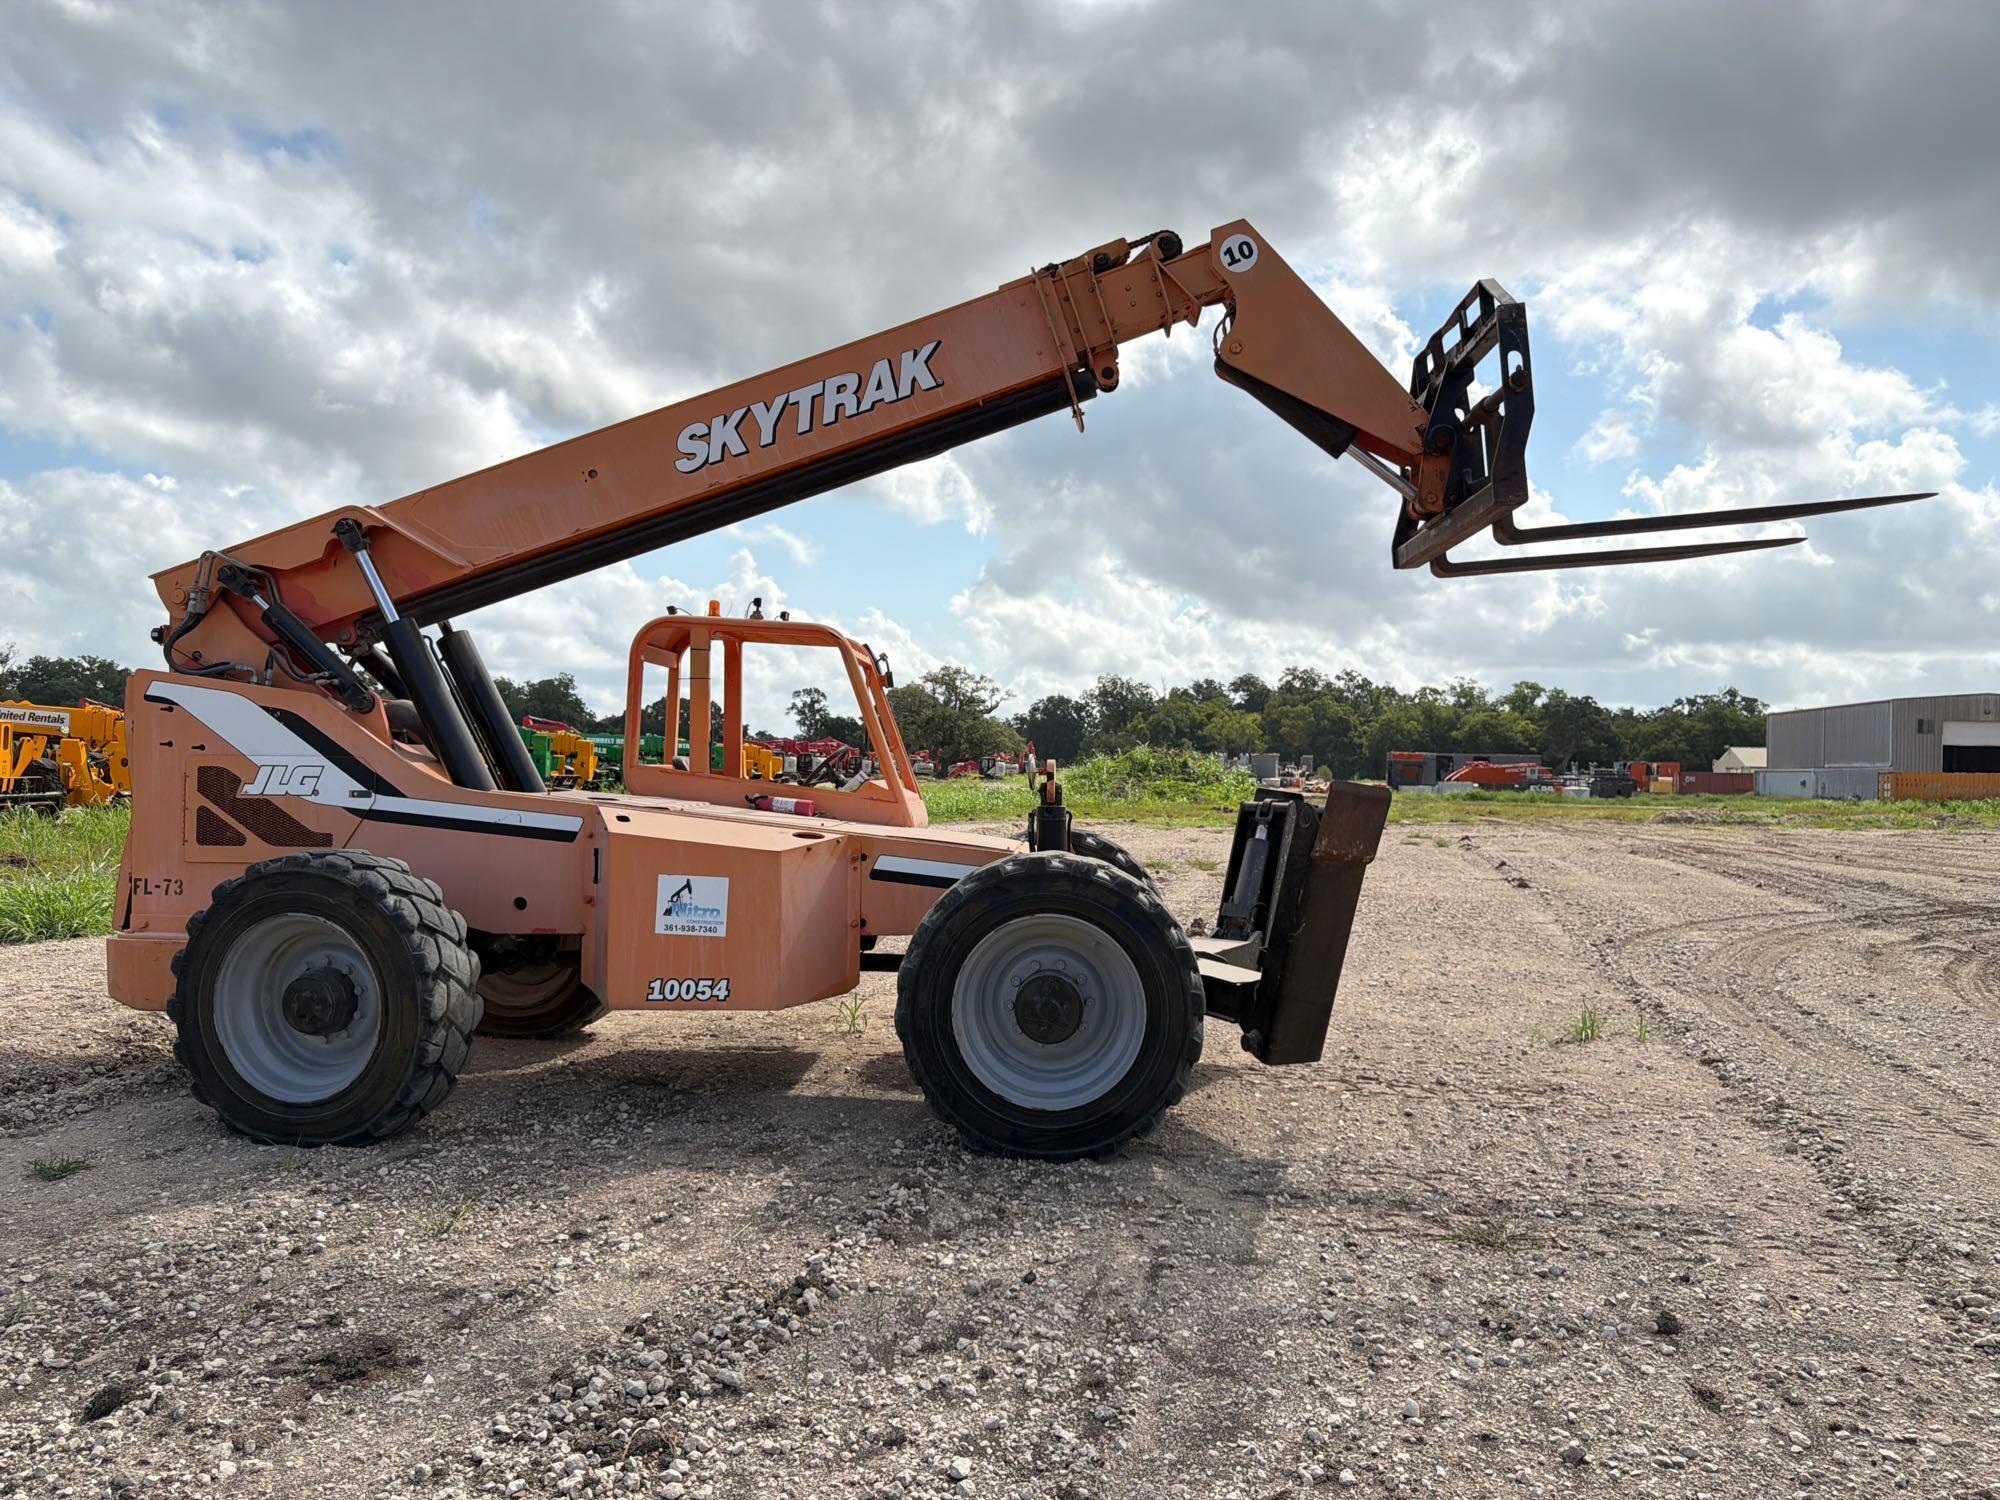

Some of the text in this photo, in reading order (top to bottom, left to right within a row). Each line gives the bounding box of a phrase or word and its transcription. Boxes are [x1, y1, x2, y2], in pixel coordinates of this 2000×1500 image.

[1223, 241, 1254, 267] 10
[673, 340, 943, 474] SKYTRAK
[0, 709, 66, 724] nited Rentals
[241, 764, 324, 797] JLG
[132, 878, 184, 896] FL-73
[672, 902, 721, 918] Nitro
[664, 923, 718, 934] 361-938-7340
[647, 978, 730, 1002] 10054
